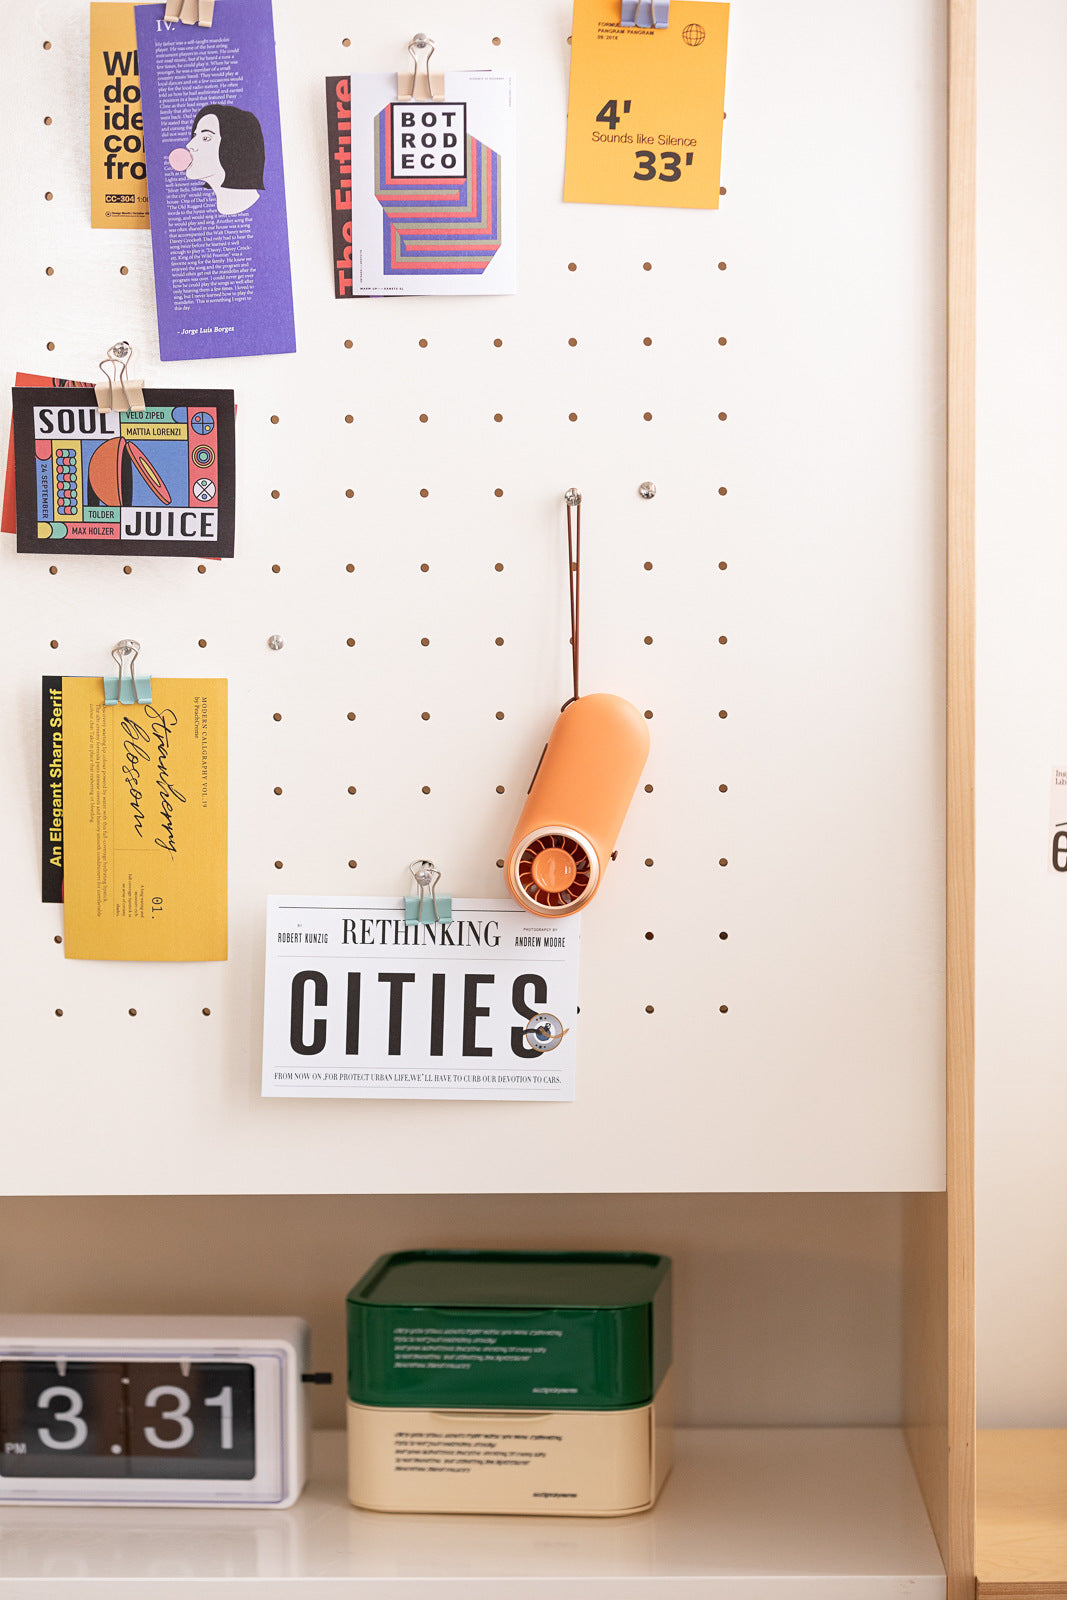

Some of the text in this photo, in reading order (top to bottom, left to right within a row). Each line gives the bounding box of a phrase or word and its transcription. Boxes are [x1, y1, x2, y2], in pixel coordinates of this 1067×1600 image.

[104, 77, 141, 103] do
[401, 112, 456, 127] BOT
[596, 99, 632, 130] 4'
[104, 134, 145, 153] co
[401, 133, 457, 148] ROD
[592, 131, 697, 146] Sounds like Silence
[401, 154, 456, 169] ECO
[633, 150, 694, 182] 33'
[334, 79, 352, 295] The Future
[181, 327, 199, 335] Jorge
[214, 326, 235, 334] Borges
[39, 409, 115, 434] SOUL
[127, 412, 165, 420] VELO ZIPED
[127, 428, 181, 436] MATTIA LORENZI
[41, 464, 47, 475] 24
[125, 512, 214, 537] JUICE
[49, 689, 63, 867] An Elegant Sharp Serif
[151, 896, 163, 918] 01.
[277, 933, 328, 944] ROBERT KUNZIG
[342, 918, 501, 947] RETHINKING
[515, 937, 565, 947] ANDREW MOORE
[290, 970, 548, 1058] CITIES
[274, 1072, 293, 1080] FROM
[339, 1073, 369, 1081] PROTECT
[434, 1074, 451, 1082] HAVE
[482, 1075, 497, 1083] OUR
[497, 1075, 531, 1083] DEVOTION
[543, 1076, 561, 1084] CARS.
[37, 1385, 233, 1450] 3 31
[4, 1443, 27, 1454] PM
